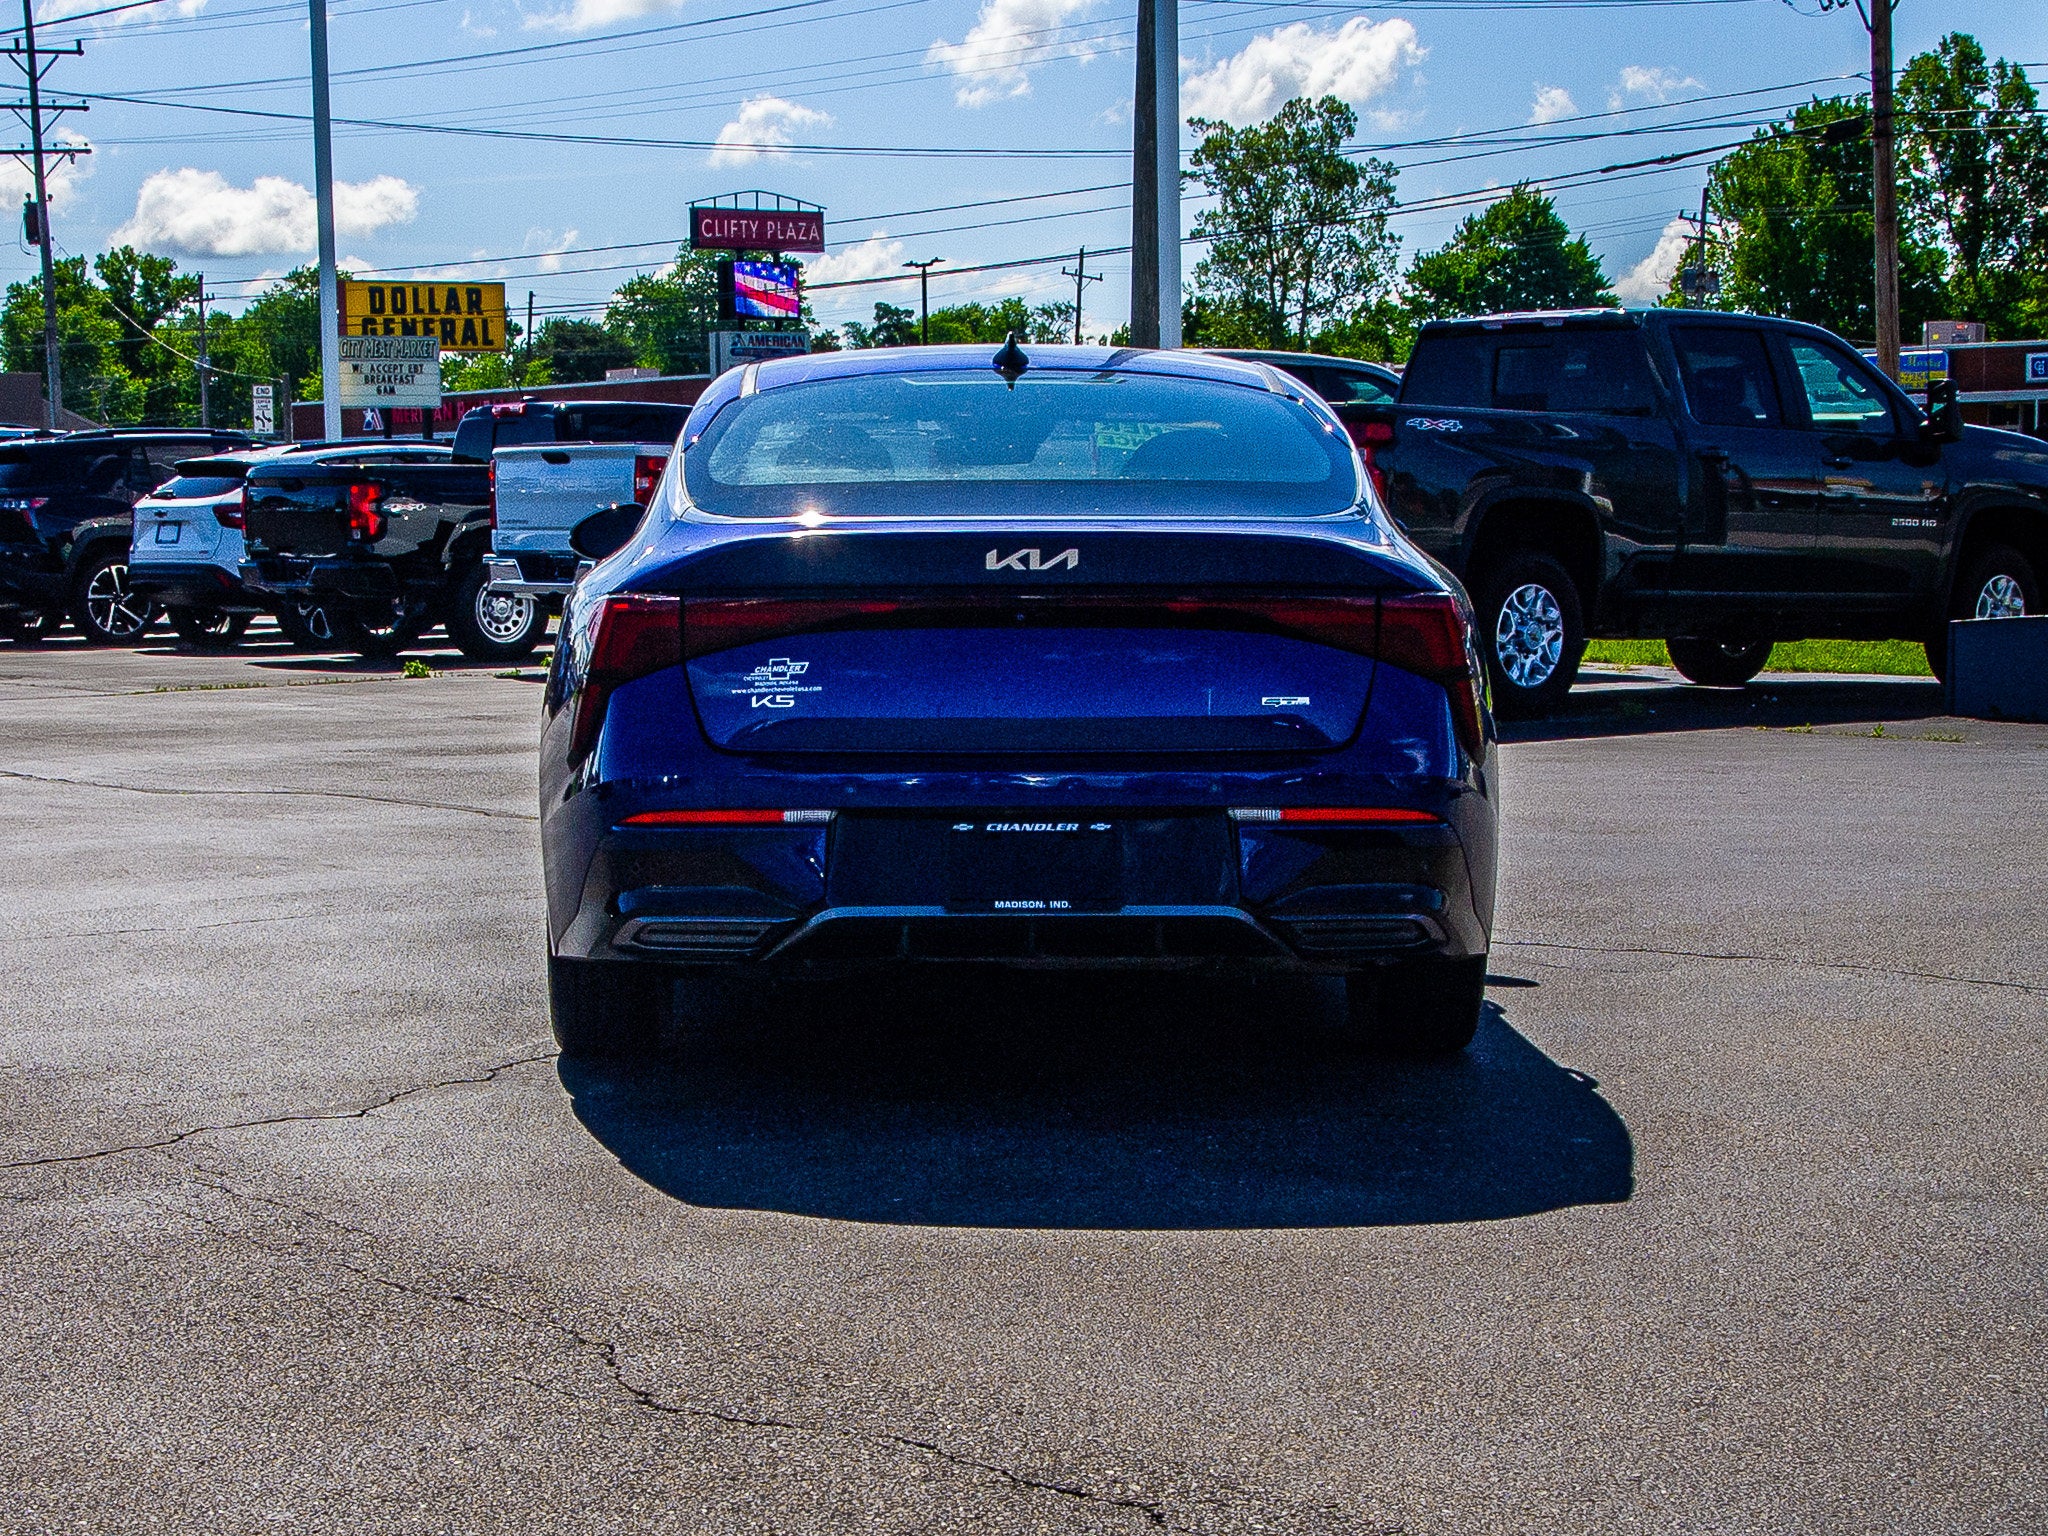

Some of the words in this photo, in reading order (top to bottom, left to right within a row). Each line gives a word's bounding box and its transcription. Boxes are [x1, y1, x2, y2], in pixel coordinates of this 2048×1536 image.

[701, 219, 758, 239] CLIFTY
[767, 221, 820, 241] PLAZA
[368, 286, 484, 315] DOLLAR
[361, 316, 495, 347] GENERAL
[749, 335, 806, 348] AMERICAN
[339, 339, 364, 358] CITY
[364, 339, 394, 358] MEAT
[396, 339, 436, 358] MARKET
[370, 363, 404, 374] ACCEPT
[364, 374, 416, 385] BREAKFAST
[256, 387, 270, 395] END
[1892, 518, 1920, 526] 2500
[986, 549, 1078, 570] KIA
[754, 665, 802, 674] CHANDLER
[751, 695, 795, 708] K5
[986, 823, 1079, 831] CHANDLER
[1050, 901, 1072, 909] IND.
